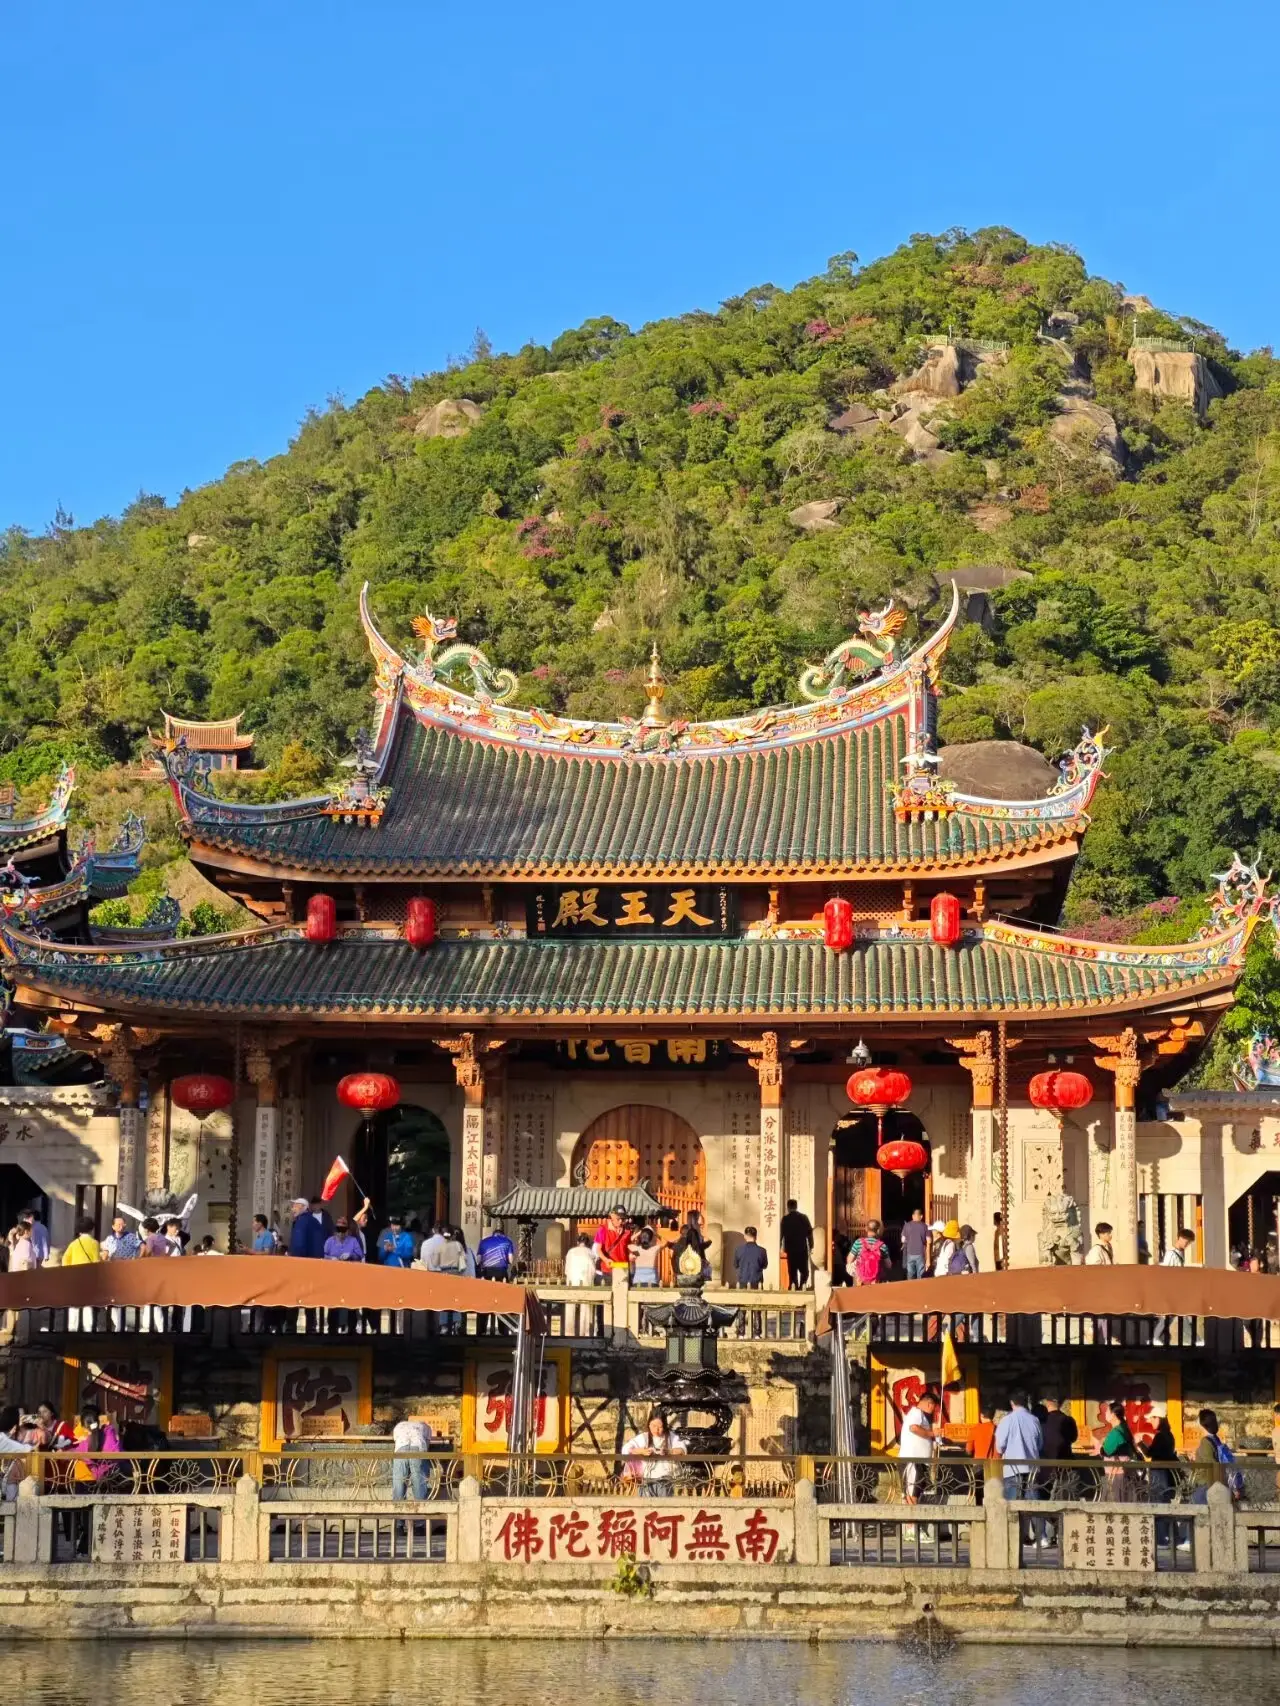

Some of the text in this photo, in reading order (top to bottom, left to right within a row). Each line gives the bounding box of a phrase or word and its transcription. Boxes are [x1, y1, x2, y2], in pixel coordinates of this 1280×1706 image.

[551, 888, 715, 929] 天王殿
[464, 1114, 480, 1225] 隔江太武拱山門
[763, 1115, 778, 1228] 分派洛伽開法宇
[169, 1508, 181, 1560] 一指金剛眼
[494, 1507, 780, 1564] 南無阿彌陀佛
